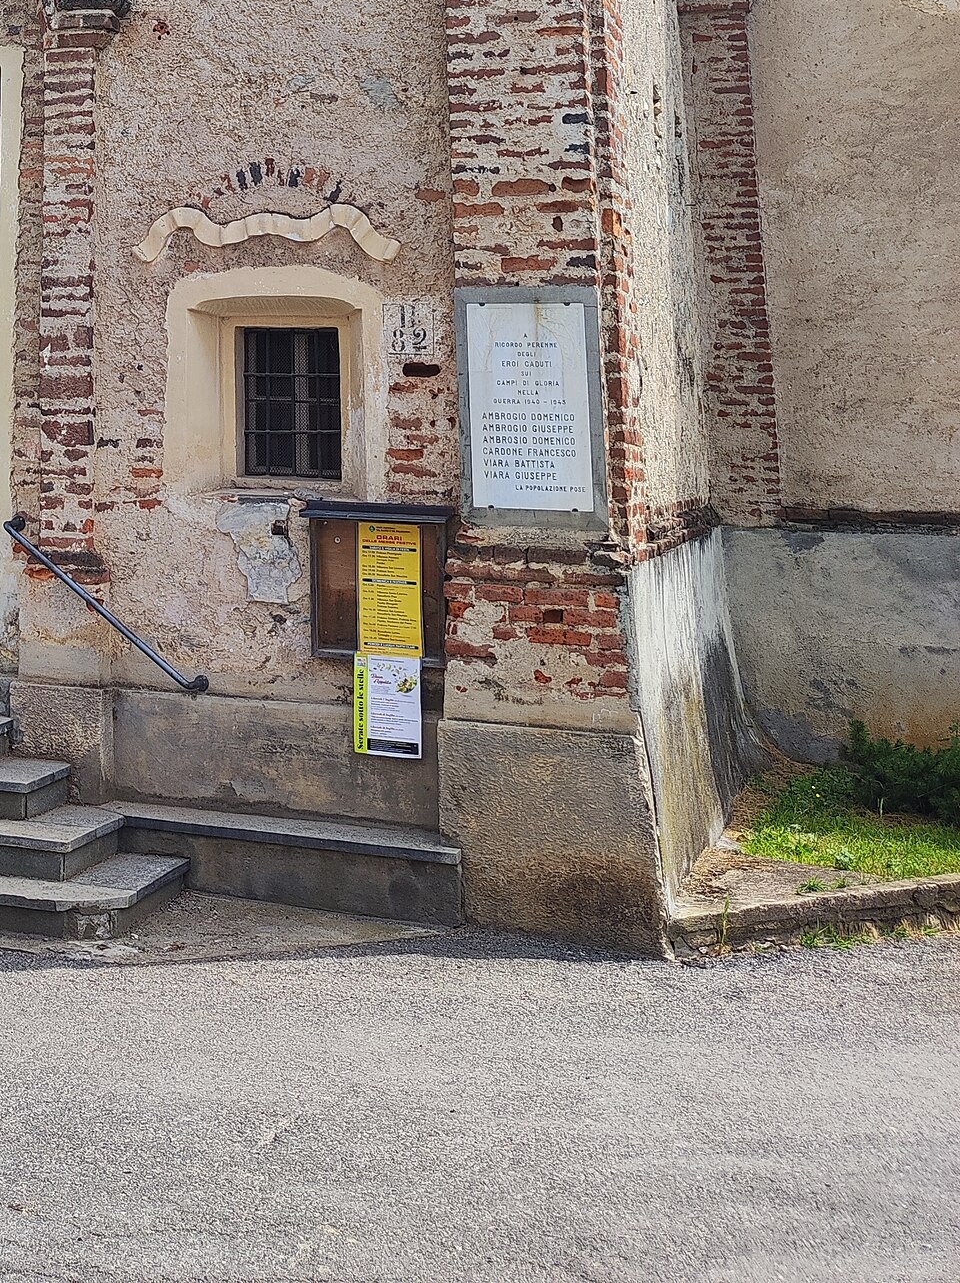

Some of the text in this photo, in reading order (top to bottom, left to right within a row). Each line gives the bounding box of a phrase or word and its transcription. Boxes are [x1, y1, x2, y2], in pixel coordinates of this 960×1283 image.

[392, 328, 427, 351] 82
[482, 413, 575, 422] AMBROGIO DOMENICO
[482, 424, 573, 433] AMBROGIO GIUSEPPE
[483, 436, 575, 445] AMBROSIO DOMENICO
[483, 447, 576, 457] CARDONE FRANCESCO
[484, 459, 555, 468] VIARA BATTISTA
[484, 471, 557, 480] VIARA GIUSEPPE
[357, 691, 364, 700] le
